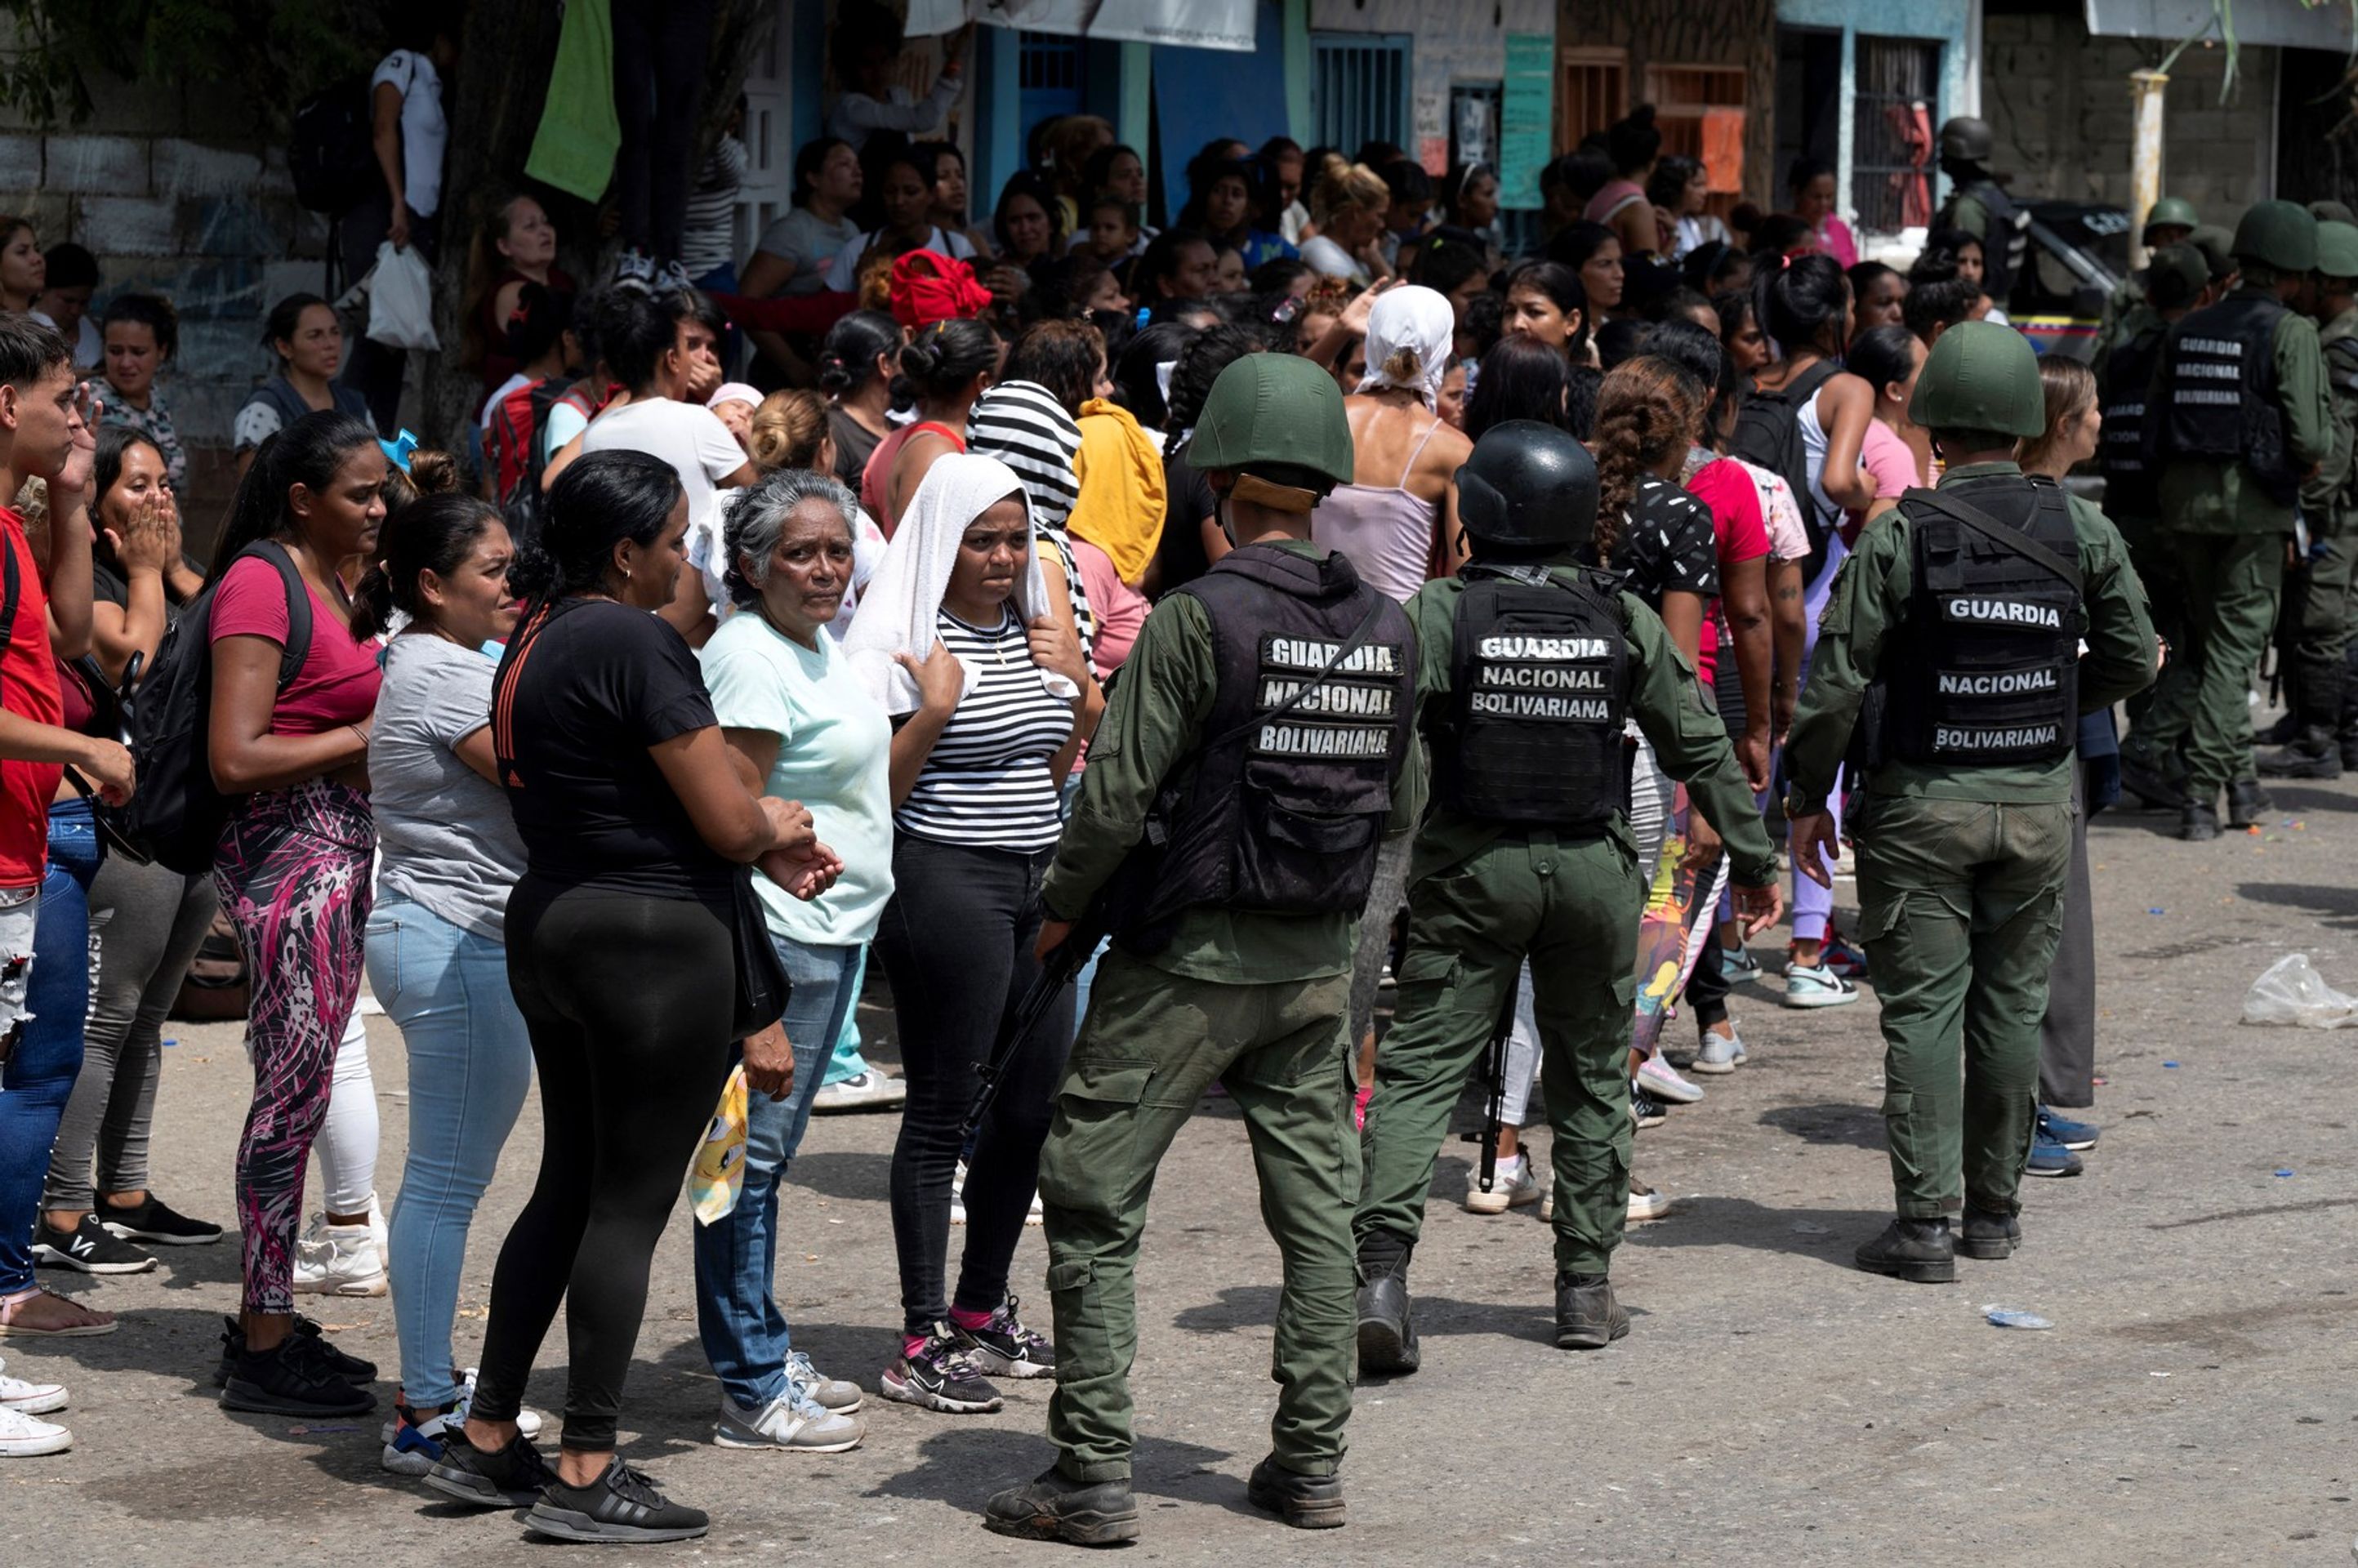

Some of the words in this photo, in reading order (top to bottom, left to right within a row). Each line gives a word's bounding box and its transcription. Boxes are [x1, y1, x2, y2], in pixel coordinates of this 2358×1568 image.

[2179, 336, 2243, 357] GUARDIA
[2175, 363, 2241, 381] NACIONAL
[1950, 599, 2060, 626] GUARDIA
[1273, 639, 1395, 672] GUARDIA
[1481, 637, 1609, 659] GUARDIA
[1482, 666, 1606, 688] NACIONAL
[1939, 669, 2056, 693] NACIONAL
[1264, 681, 1393, 716] NACIONAL
[1471, 692, 1609, 719] BOLIVARIANA
[1259, 725, 1389, 755] BOLIVARIANA
[1937, 726, 2056, 748] BOLIVARIANA
